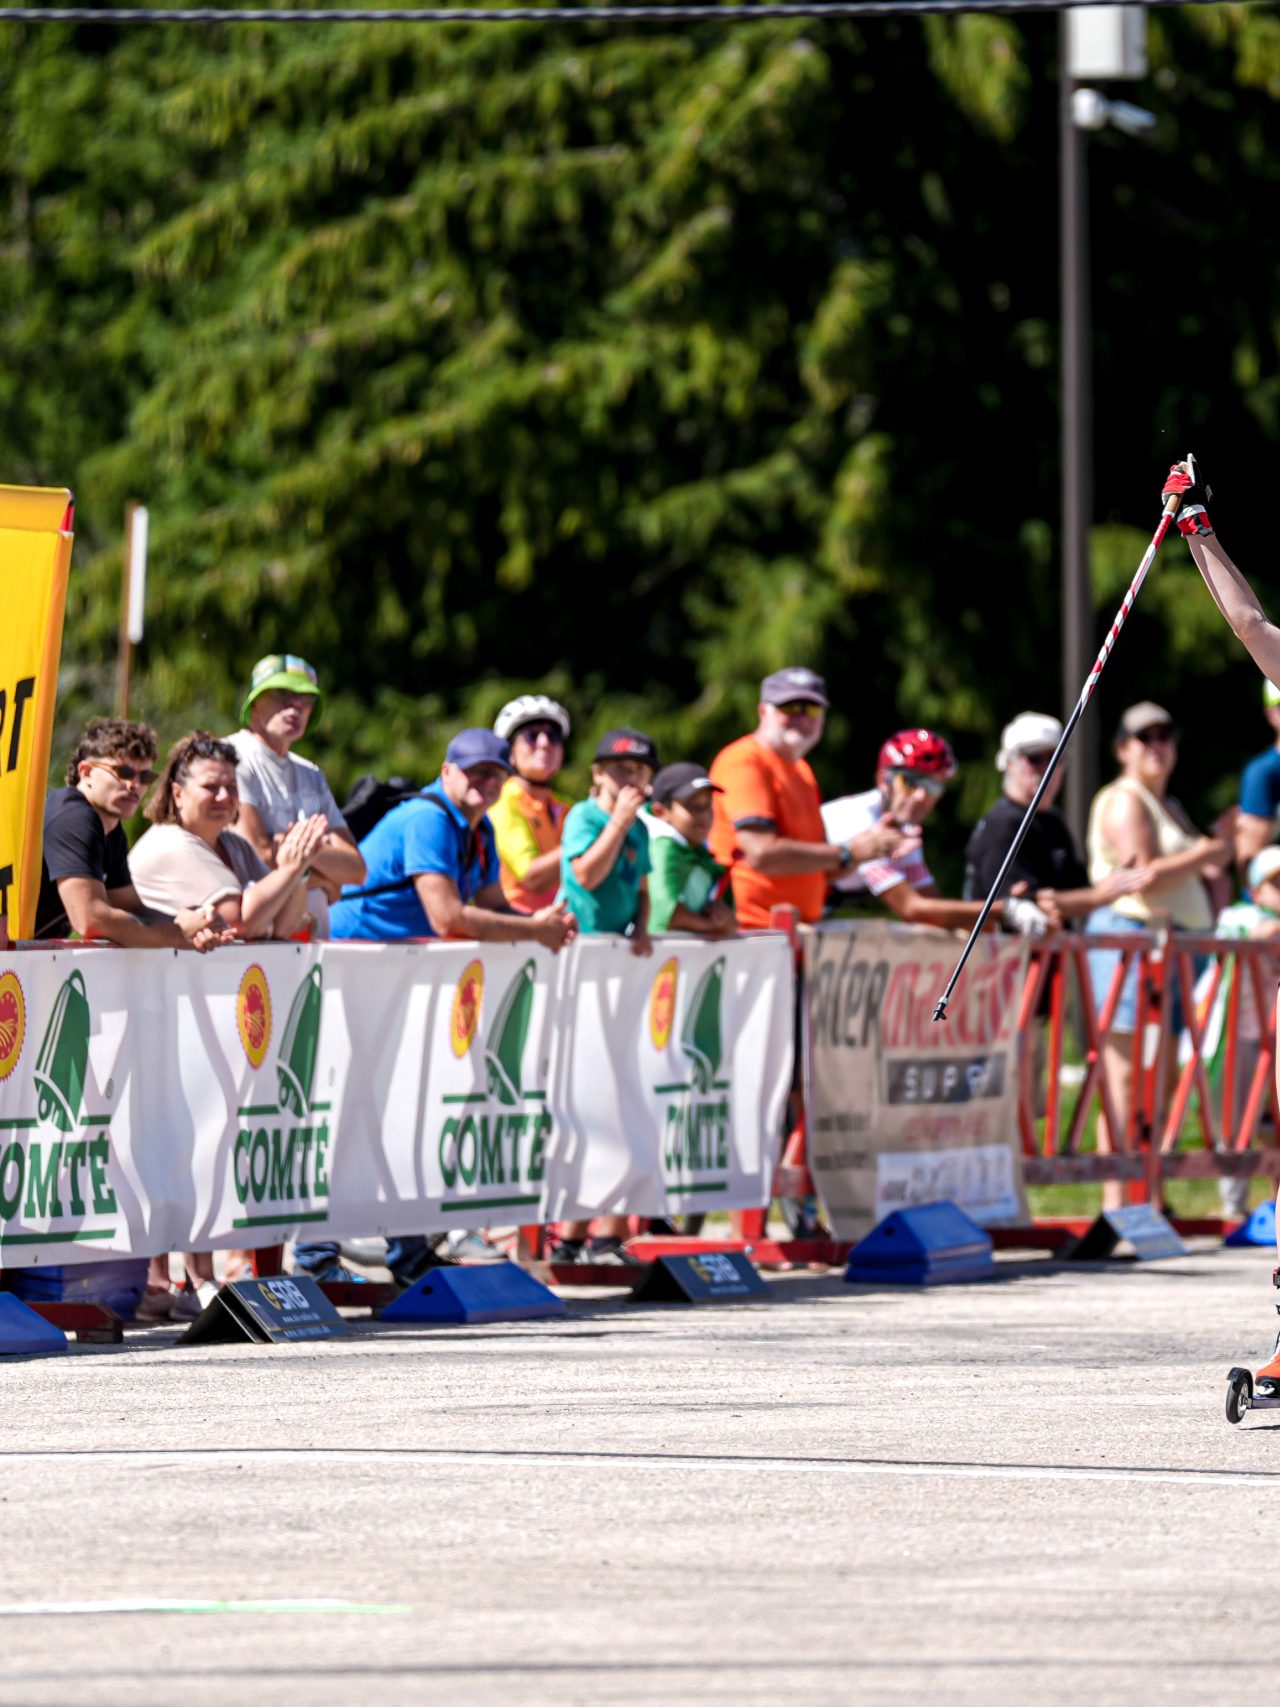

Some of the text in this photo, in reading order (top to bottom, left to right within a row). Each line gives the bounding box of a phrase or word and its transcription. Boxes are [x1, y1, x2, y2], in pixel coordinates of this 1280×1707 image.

[0, 1131, 118, 1222] OMTÉ
[234, 1117, 329, 1204] COMTÉ
[438, 1104, 553, 1189] COMTÉ
